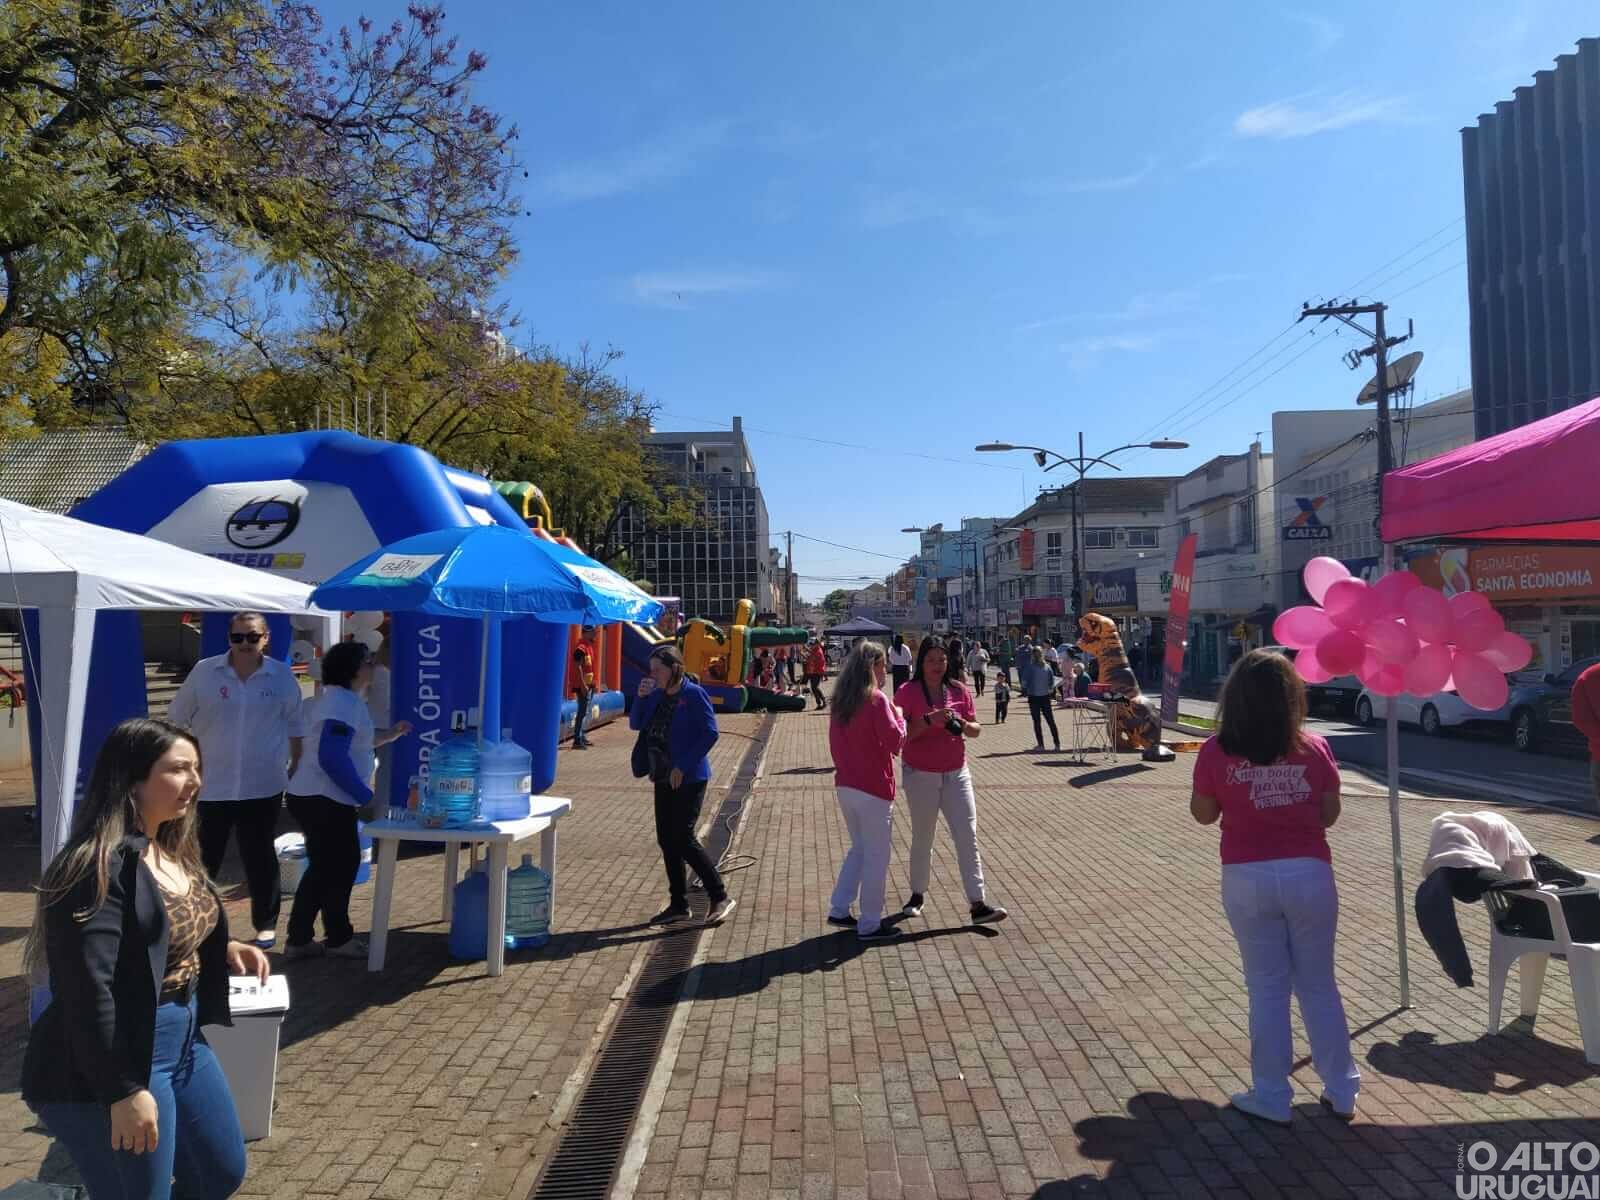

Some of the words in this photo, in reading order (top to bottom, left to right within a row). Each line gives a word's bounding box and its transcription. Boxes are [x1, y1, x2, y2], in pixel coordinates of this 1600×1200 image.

[1287, 527, 1329, 539] CAIXA
[1475, 575, 1516, 593] SANTA
[1520, 569, 1593, 590] ECONOMIA
[413, 624, 441, 721] ÓPTICA
